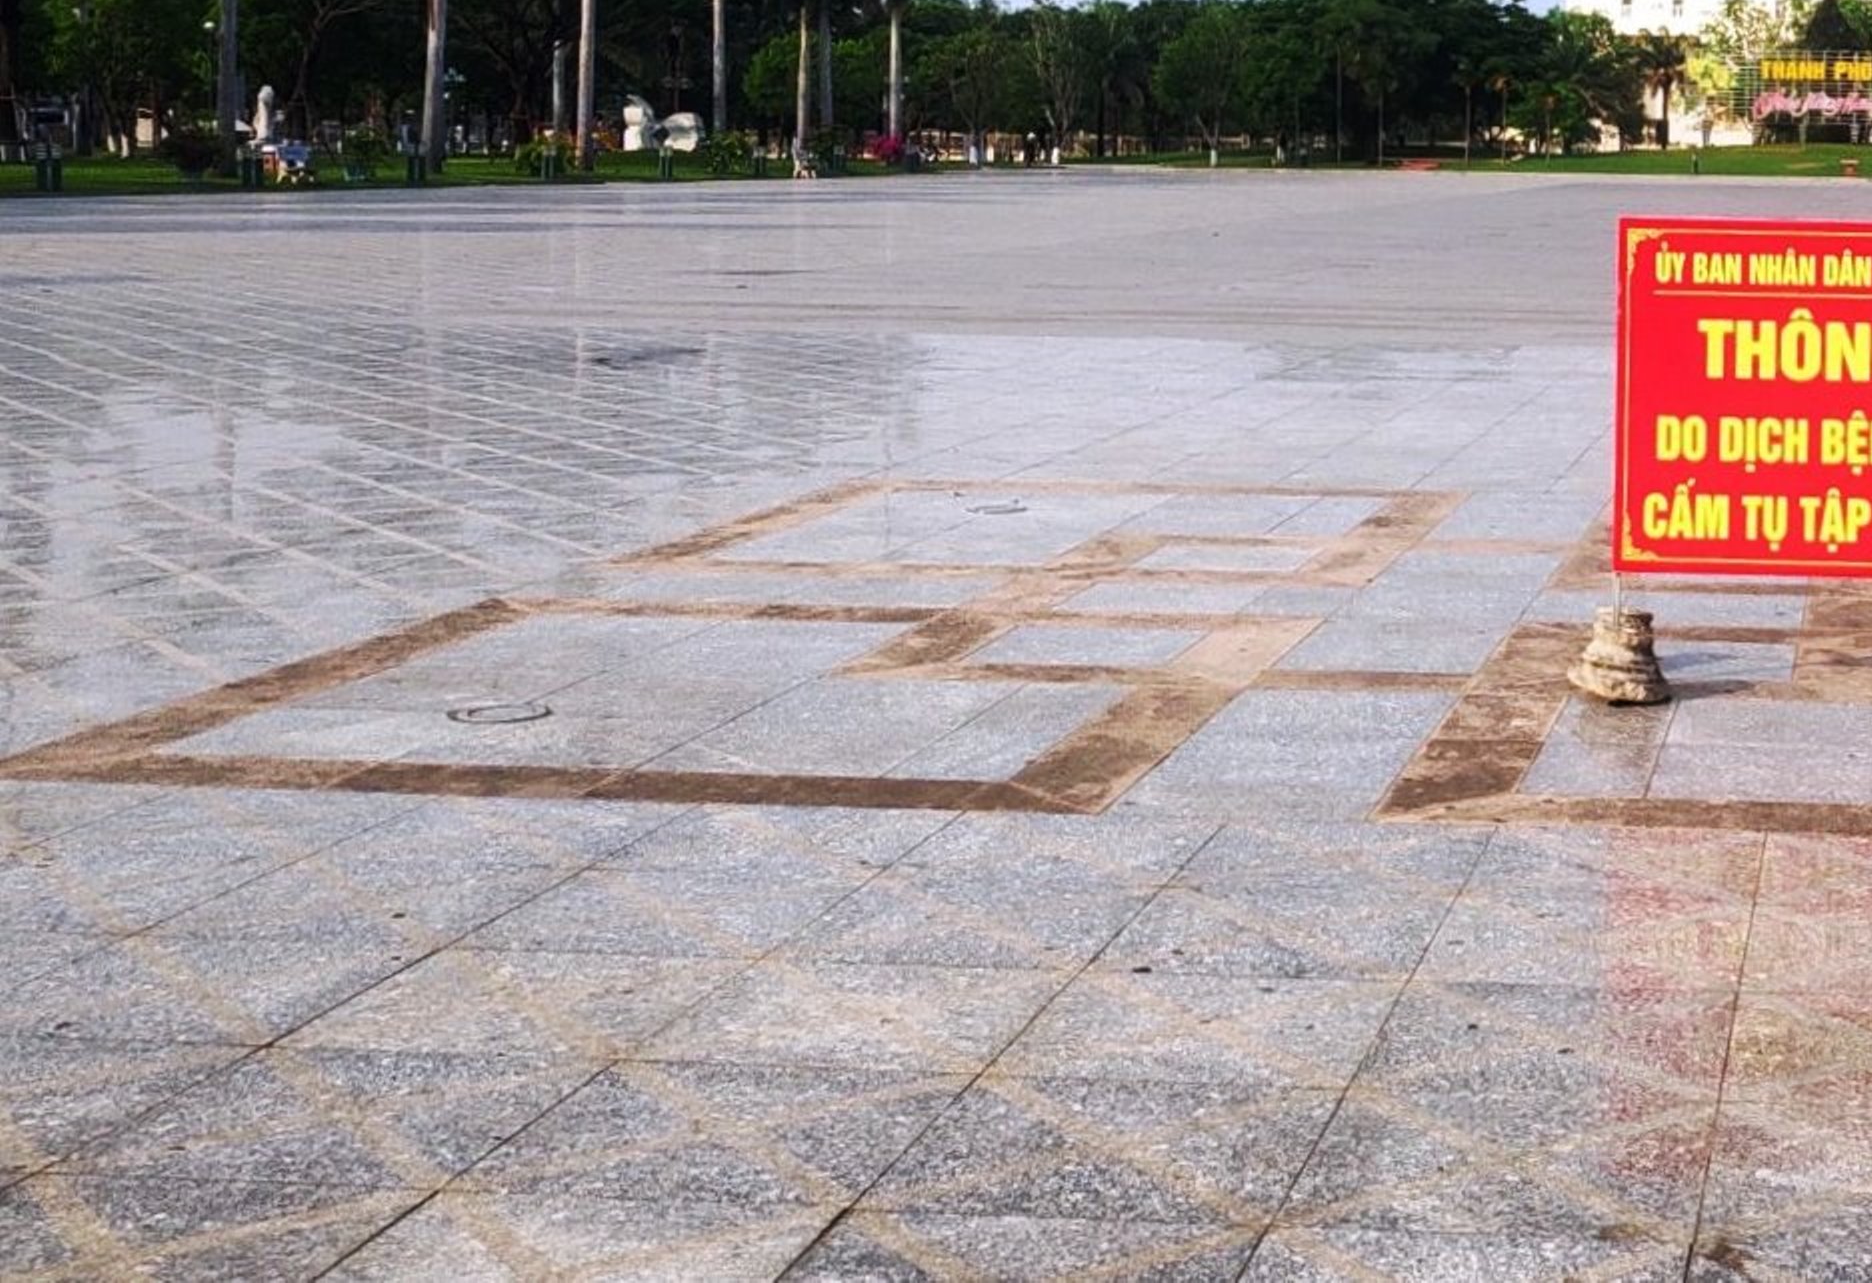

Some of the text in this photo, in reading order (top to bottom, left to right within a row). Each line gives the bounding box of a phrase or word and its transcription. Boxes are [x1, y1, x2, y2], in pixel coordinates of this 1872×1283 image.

[1655, 241, 1686, 283] ỦY
[1693, 252, 1743, 285] BAN
[1749, 247, 1817, 287] NHÂN
[1823, 248, 1872, 288] DÂN
[1656, 415, 1708, 463] DO
[1719, 416, 1810, 473] DỊCH
[1643, 477, 1731, 540] CẤM
[1742, 495, 1789, 552] TỤ
[1799, 487, 1872, 554] TẬP
